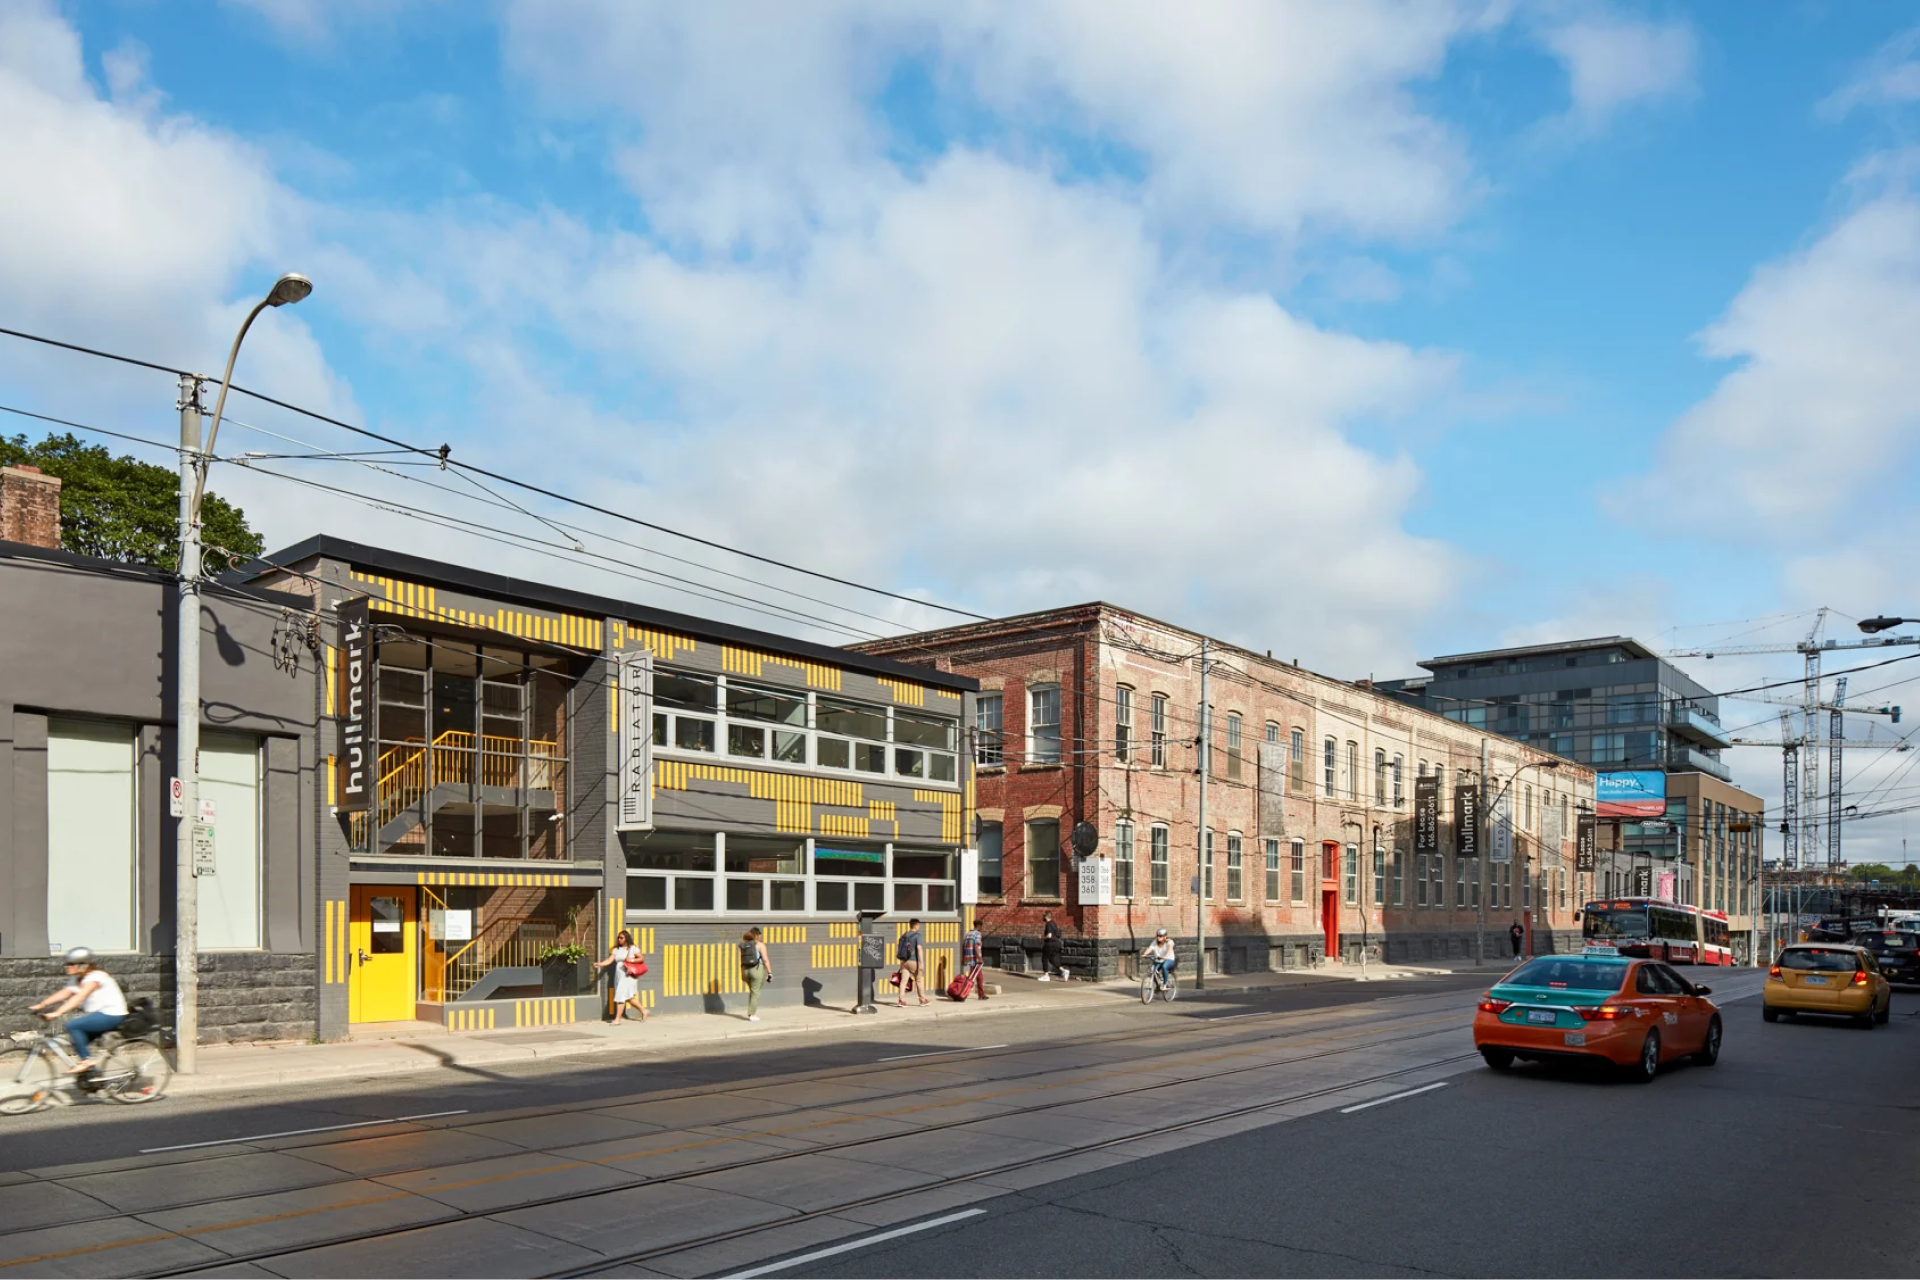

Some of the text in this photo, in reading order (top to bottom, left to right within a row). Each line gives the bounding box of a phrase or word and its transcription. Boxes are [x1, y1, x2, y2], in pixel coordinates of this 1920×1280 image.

[345, 616, 363, 794] hullmark
[632, 667, 642, 793] RADIATOR
[1599, 777, 1639, 788] Happy.
[1418, 807, 1426, 848] For Lease
[1460, 791, 1474, 853] hullmark
[1081, 865, 1095, 874] 350
[1081, 875, 1095, 884] 358
[1081, 885, 1095, 894] 360
